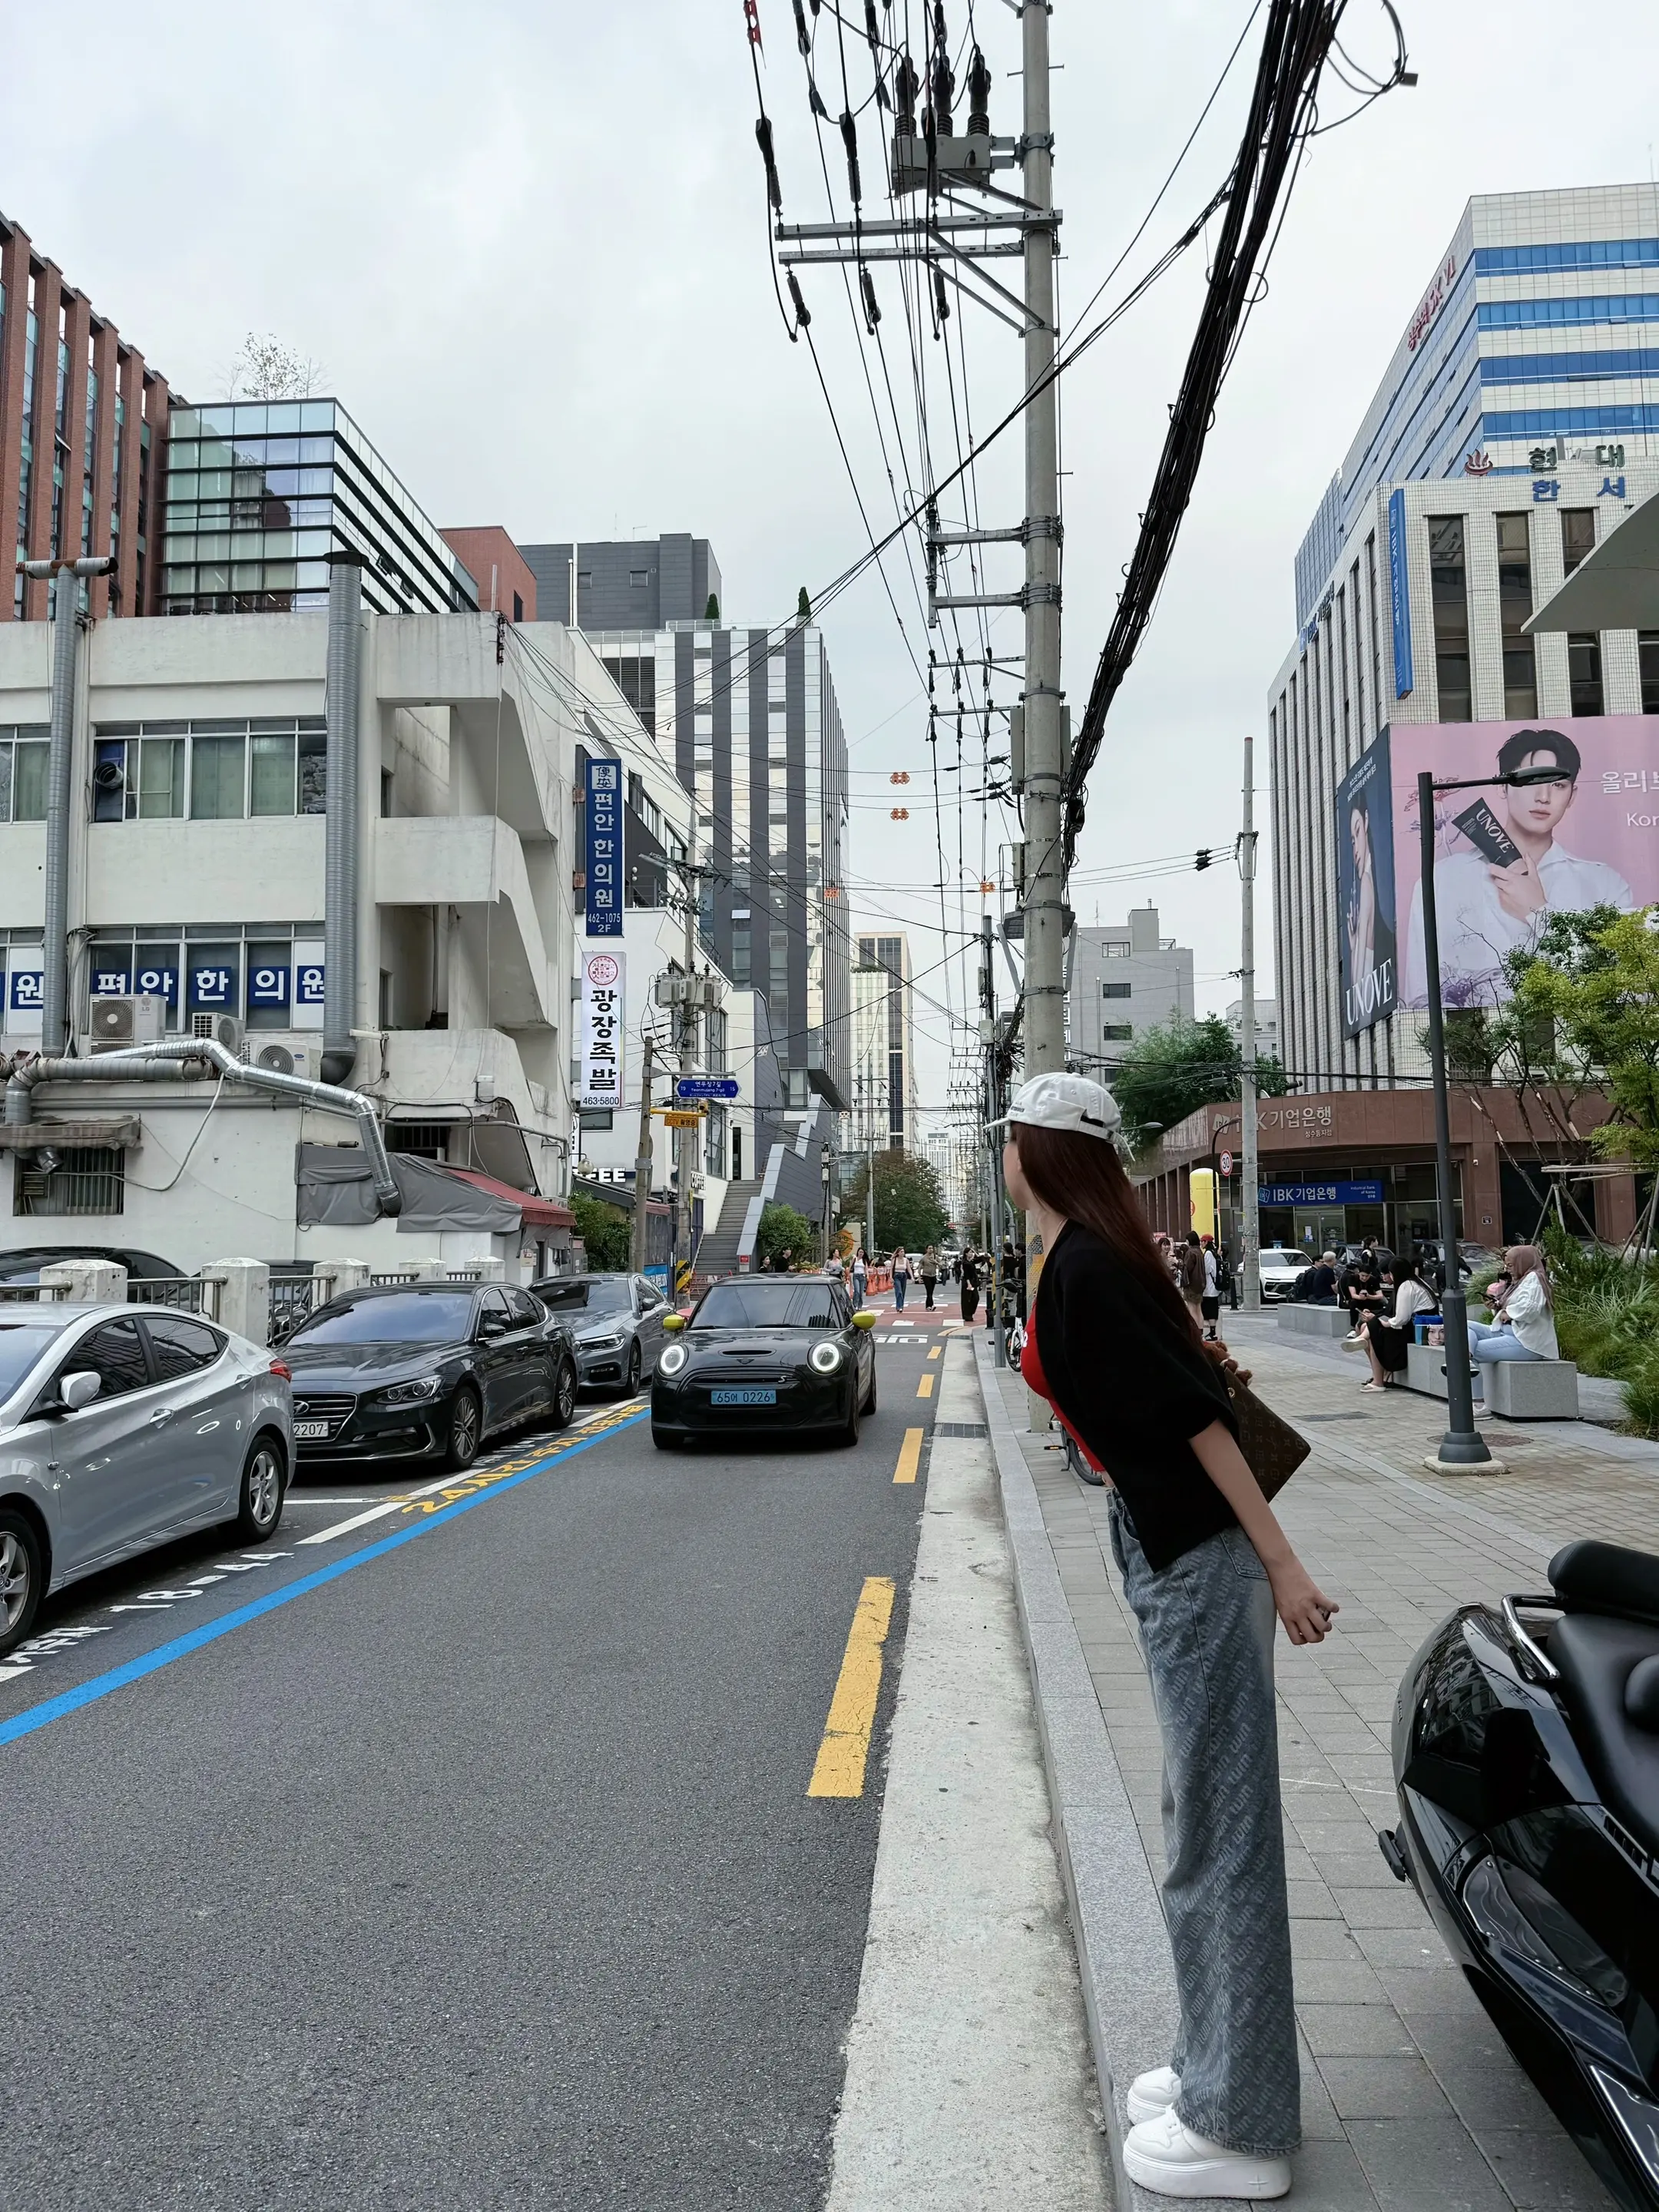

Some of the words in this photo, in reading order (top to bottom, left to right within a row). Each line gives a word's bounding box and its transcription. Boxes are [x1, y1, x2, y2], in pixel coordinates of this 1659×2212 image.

[1476, 807, 1515, 853] UNOVE
[588, 912, 621, 923] 462-1075
[598, 924, 611, 932] 2F
[1345, 958, 1394, 1025] UNOVE
[589, 989, 618, 1091] 광장족발
[1221, 1157, 1230, 1169] 30
[717, 1392, 738, 1403] 65어
[742, 1391, 770, 1402] 0226
[293, 1423, 323, 1435] 2207
